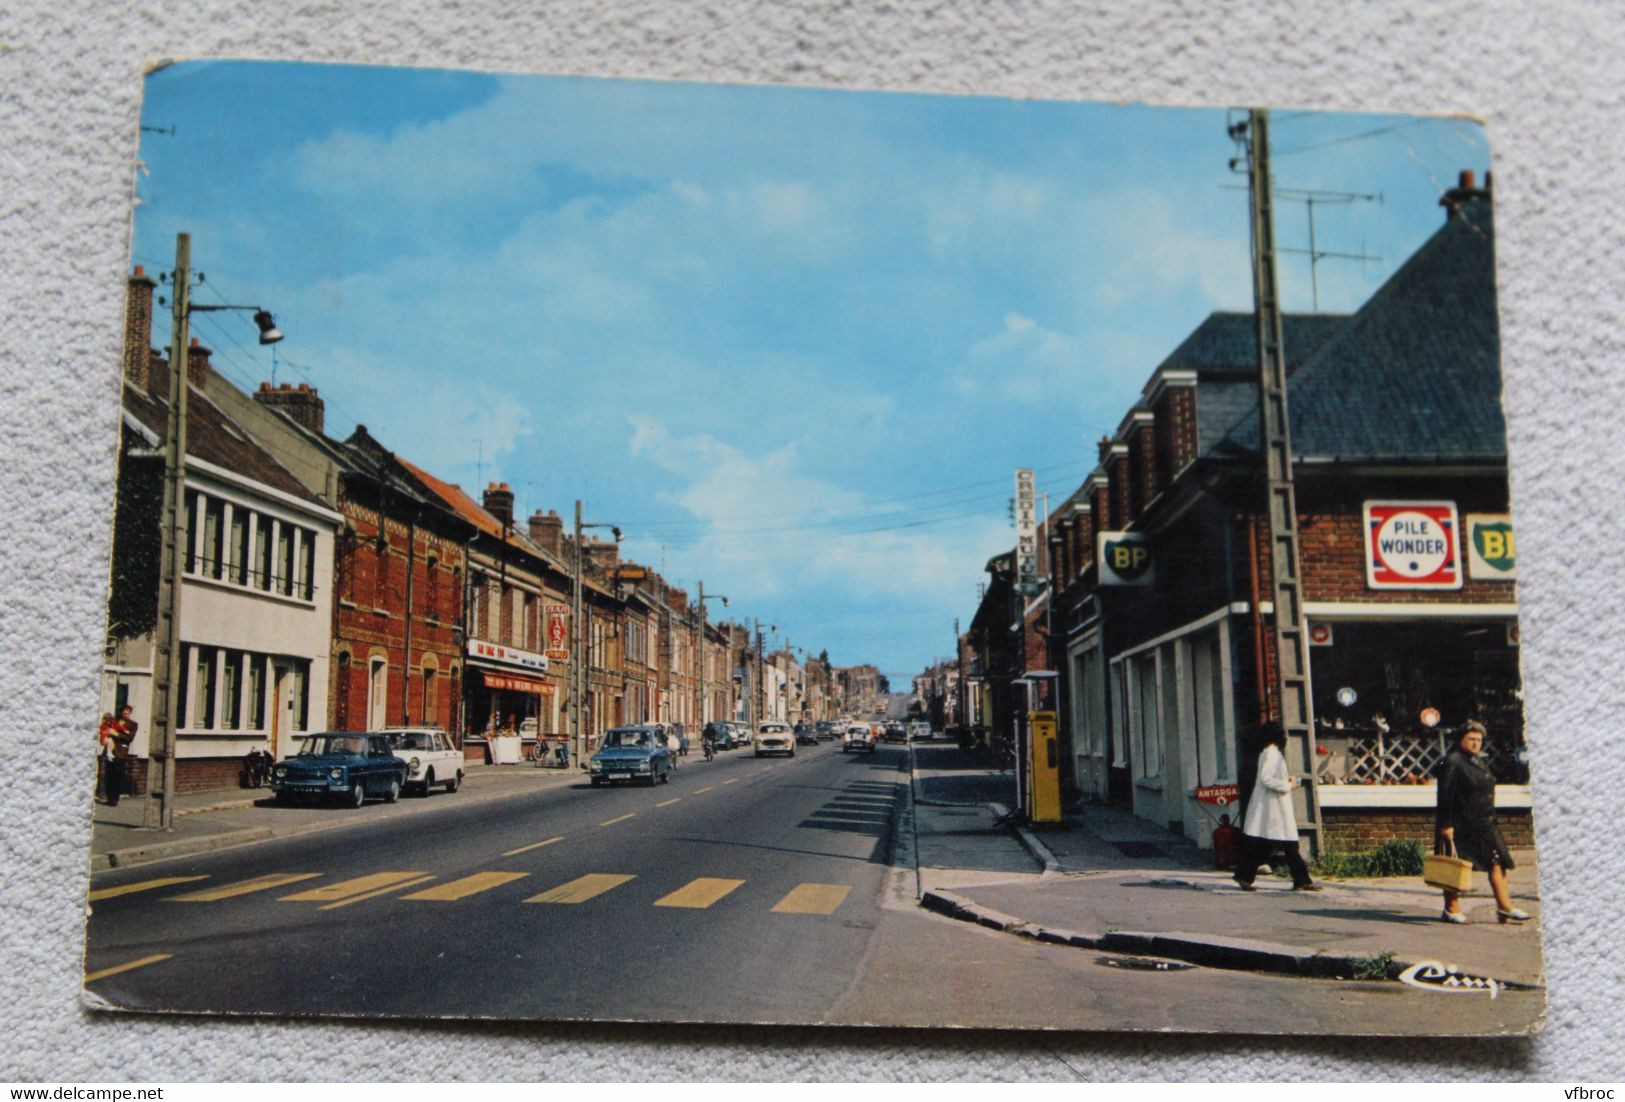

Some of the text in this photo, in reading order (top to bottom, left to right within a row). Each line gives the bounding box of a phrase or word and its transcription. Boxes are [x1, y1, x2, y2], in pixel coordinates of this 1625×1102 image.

[1017, 471, 1033, 529] CREDIT
[1394, 521, 1429, 535] PILE
[1381, 538, 1445, 554] WONDER
[1114, 547, 1147, 569] BP
